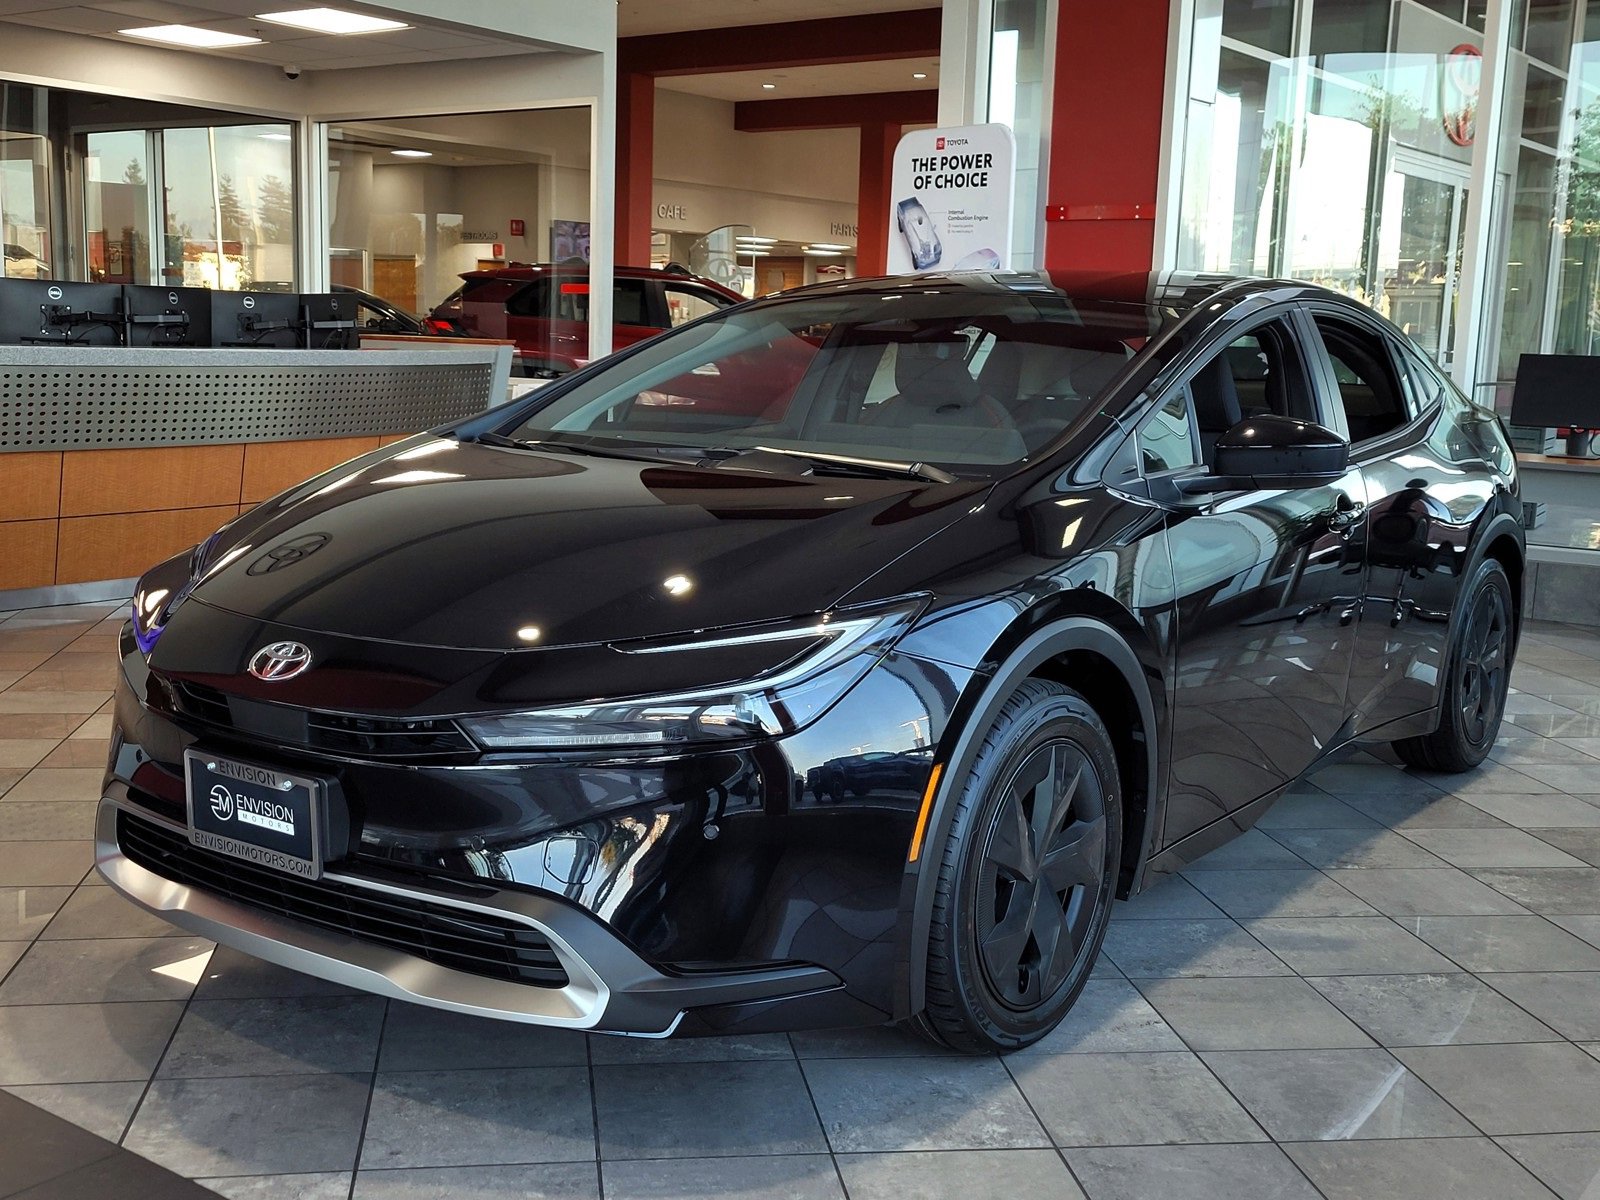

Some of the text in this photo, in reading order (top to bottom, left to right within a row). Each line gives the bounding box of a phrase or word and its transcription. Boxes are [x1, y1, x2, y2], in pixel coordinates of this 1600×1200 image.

[946, 138, 969, 146] TOYOTA
[911, 153, 992, 172] THE POWER
[913, 172, 988, 190] OF CHOICE
[657, 204, 687, 220] CAFE
[974, 214, 989, 222] Engine
[830, 222, 859, 238] PARTS
[219, 761, 276, 786] ENVISION
[236, 794, 294, 823] ENVISION
[242, 812, 291, 832] MOTORS
[194, 832, 313, 876] ENVISIONMOTORS.COM
